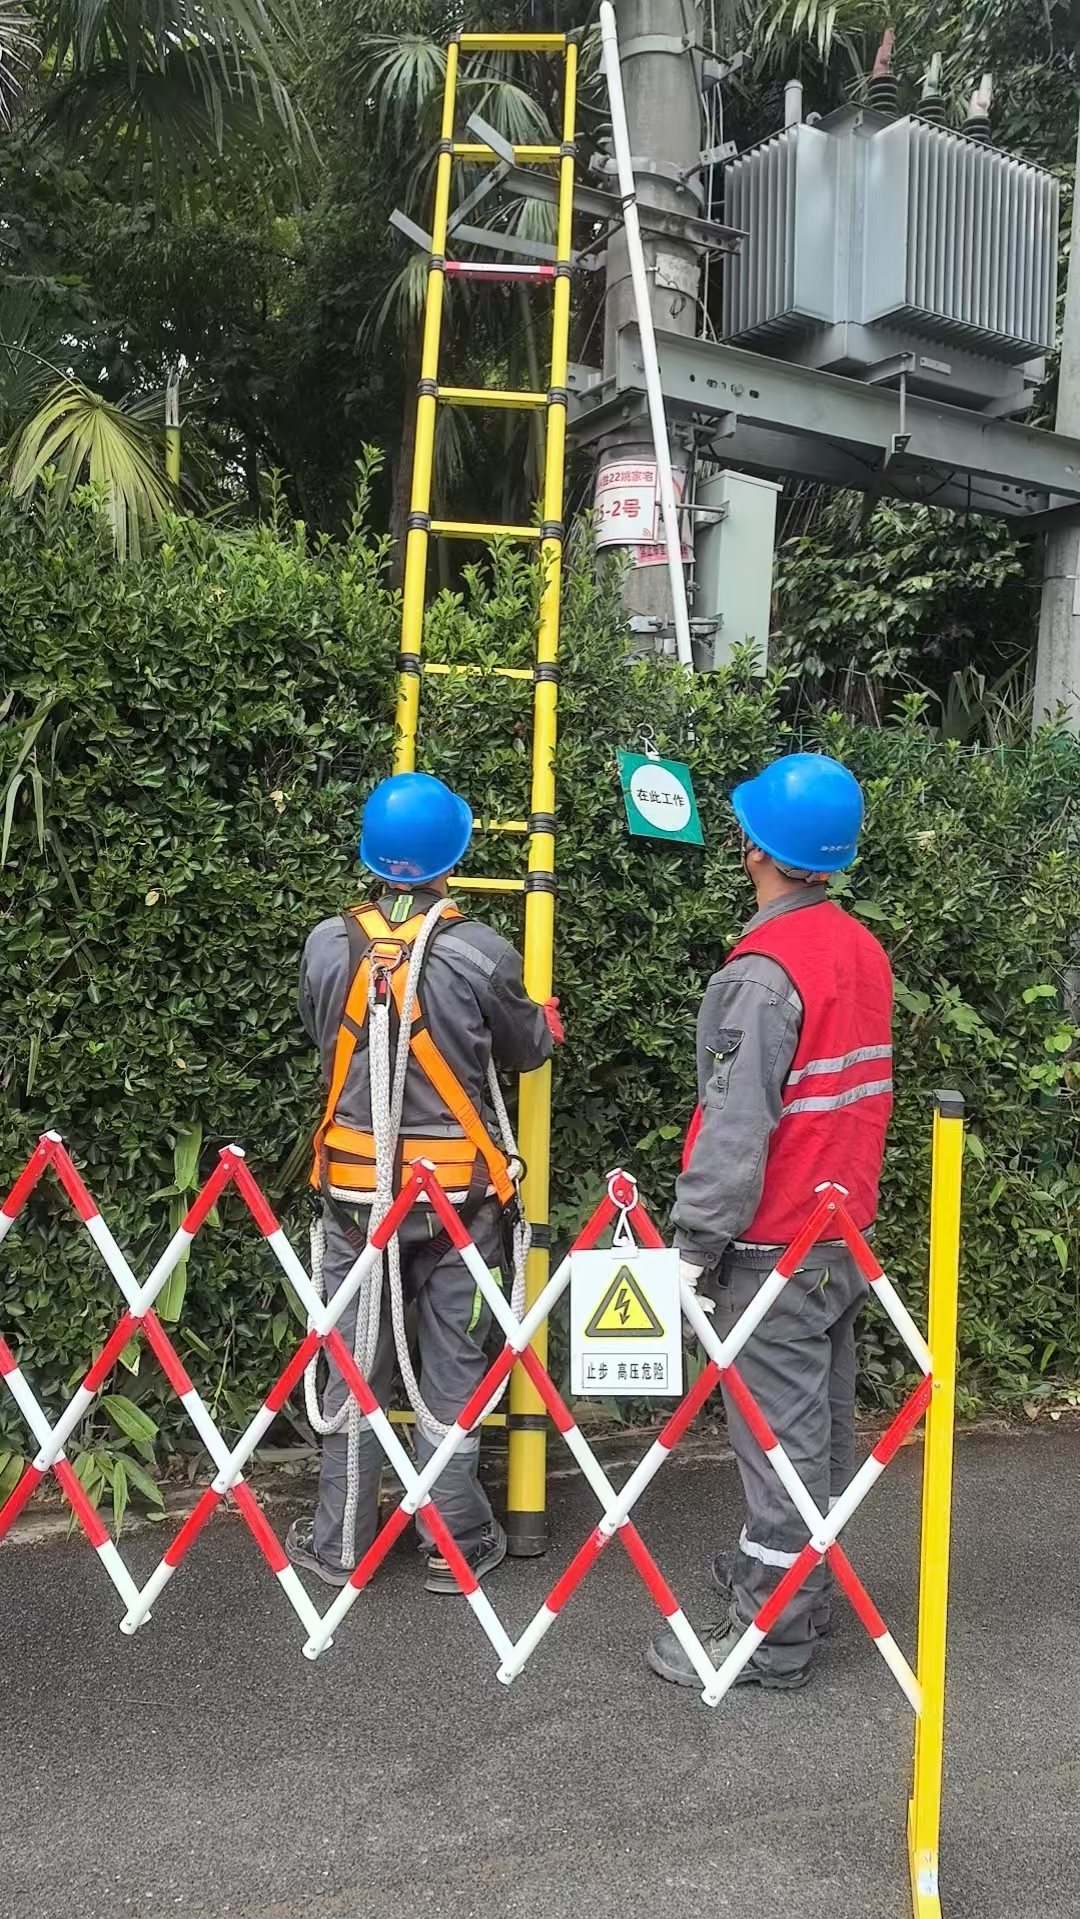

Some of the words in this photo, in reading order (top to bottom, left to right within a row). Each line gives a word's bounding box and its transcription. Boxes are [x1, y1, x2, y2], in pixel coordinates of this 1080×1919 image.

[636, 788, 685, 807] 在此工作
[586, 1362, 609, 1380] 止步
[617, 1362, 664, 1380] 高压危险
